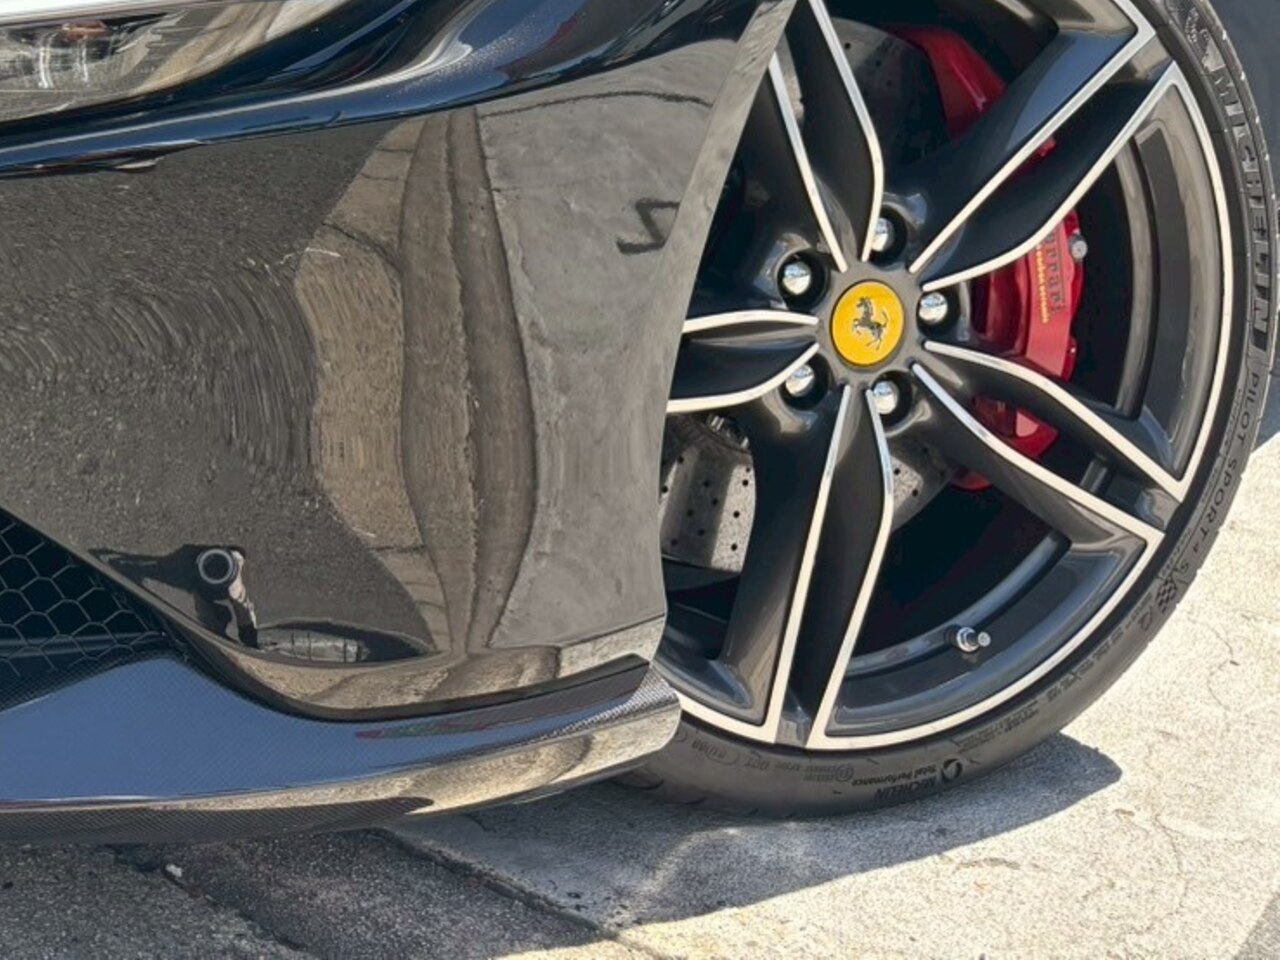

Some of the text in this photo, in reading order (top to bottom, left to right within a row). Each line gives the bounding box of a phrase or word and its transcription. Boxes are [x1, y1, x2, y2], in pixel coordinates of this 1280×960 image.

[1045, 230, 1066, 314] errari
[1236, 371, 1261, 447] PILOT
[1199, 457, 1238, 541] SPORT
